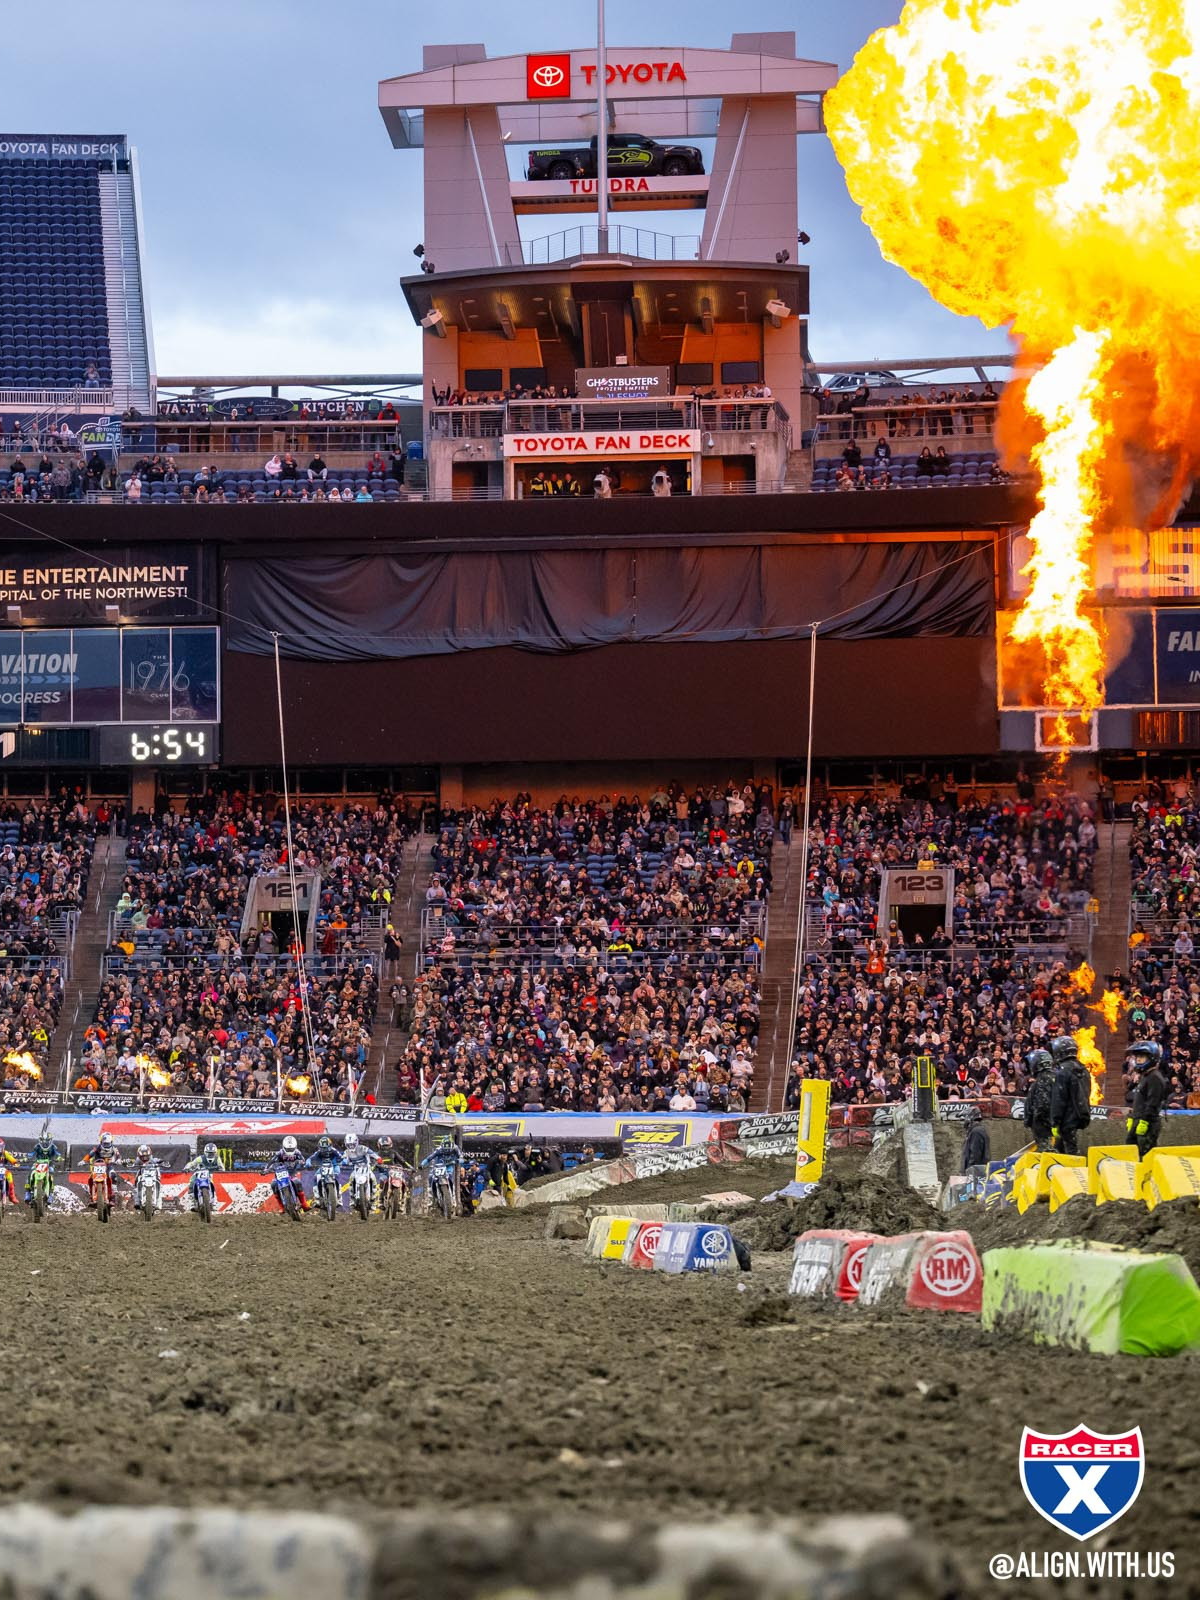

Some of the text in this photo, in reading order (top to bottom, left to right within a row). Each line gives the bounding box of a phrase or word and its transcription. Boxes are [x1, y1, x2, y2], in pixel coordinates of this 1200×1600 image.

[581, 62, 686, 85] TOYOTA
[51, 143, 79, 155] FAN
[82, 143, 120, 156] DECK
[570, 178, 649, 194] TUDRA
[513, 434, 690, 451] TOYOTA FAN DECK
[23, 566, 189, 585] ENTERTAINMENT
[41, 588, 61, 600] OF
[64, 588, 91, 600] THE
[96, 586, 188, 599] NORTHWEST!
[130, 661, 190, 691] 1976
[131, 729, 204, 760] 6:54
[264, 883, 308, 897] 121
[894, 876, 943, 891] 123
[752, 1117, 779, 1127] ROCKY
[933, 1258, 964, 1280] RM
